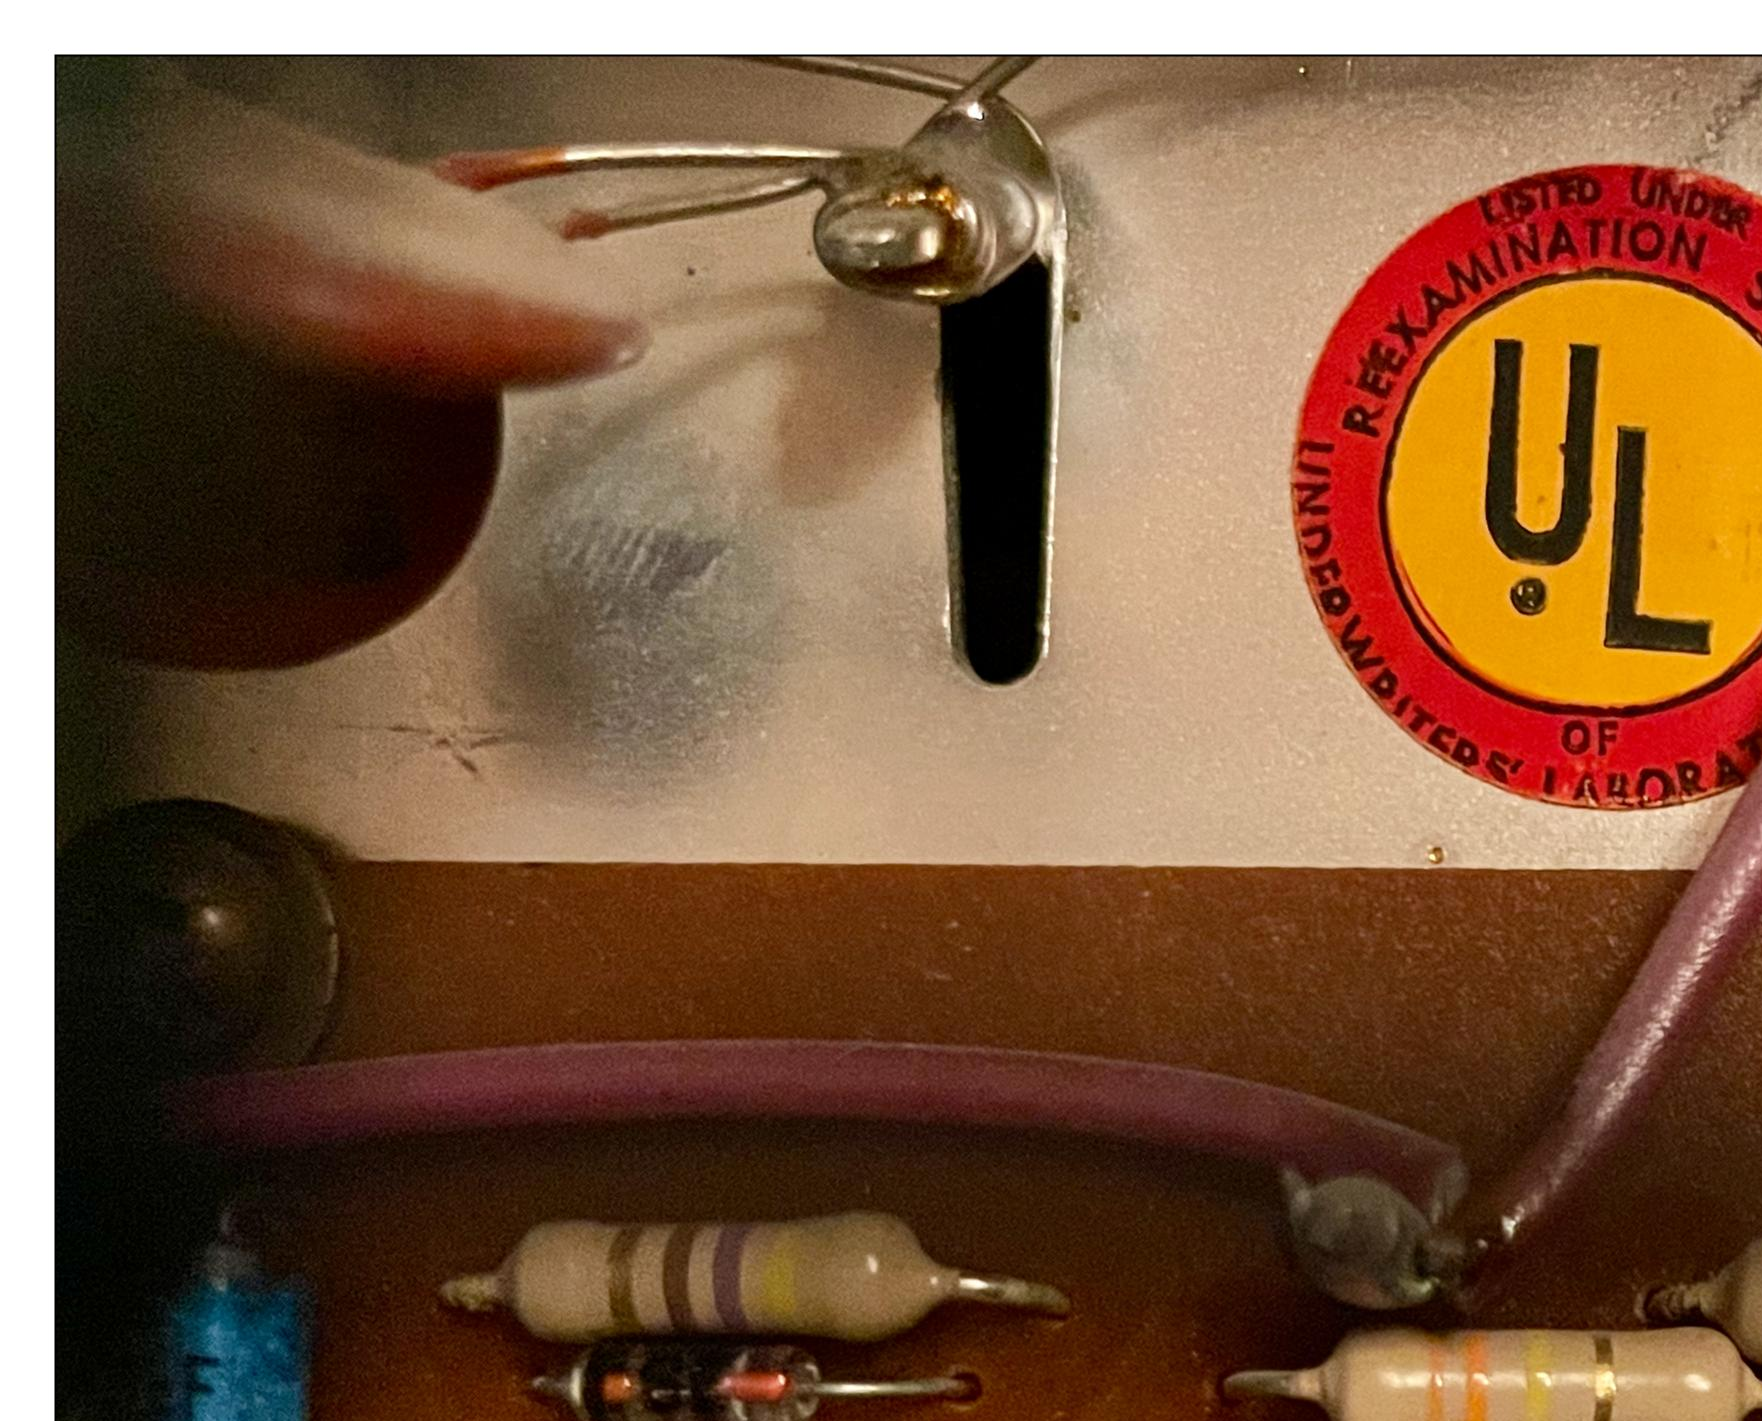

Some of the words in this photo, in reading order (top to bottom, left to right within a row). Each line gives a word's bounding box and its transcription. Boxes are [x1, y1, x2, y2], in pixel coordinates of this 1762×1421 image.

[1477, 172, 1602, 225] LISTED
[1631, 166, 1750, 240] UNDER
[1484, 338, 1713, 655] UL
[1561, 719, 1620, 757] OF
